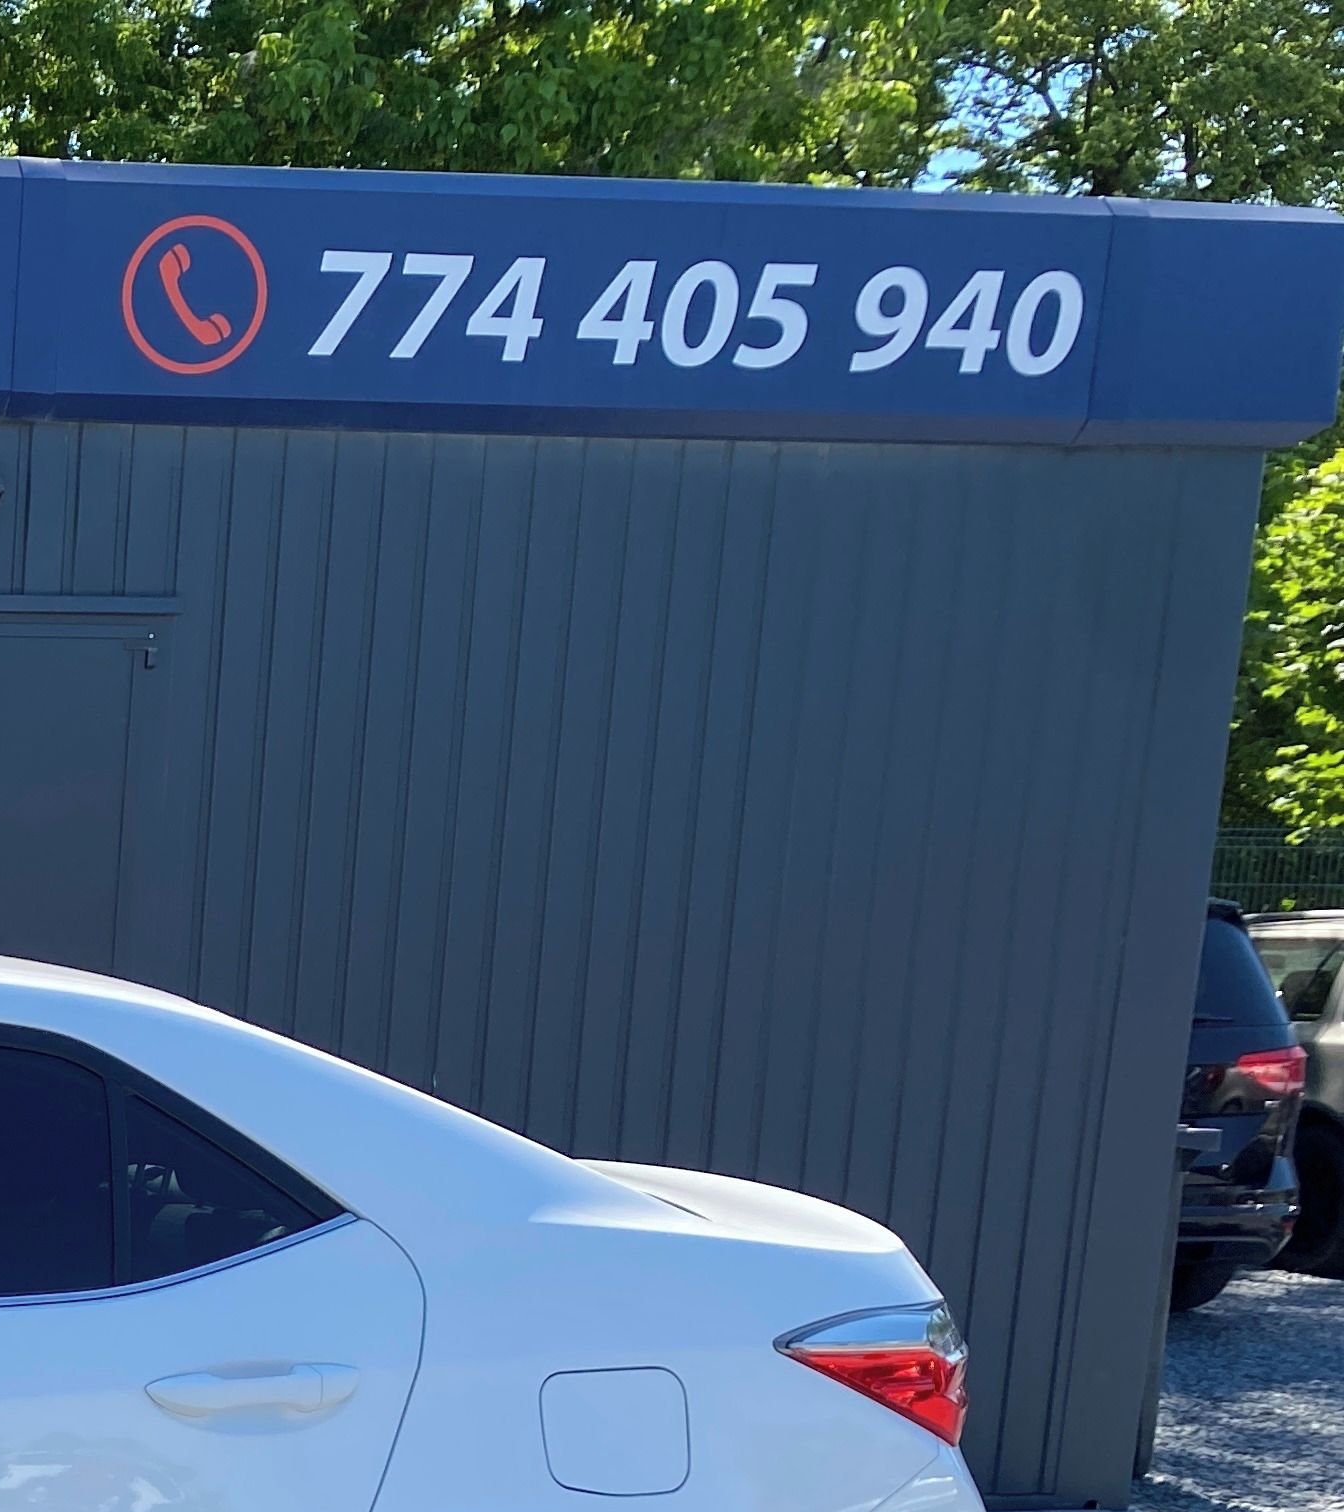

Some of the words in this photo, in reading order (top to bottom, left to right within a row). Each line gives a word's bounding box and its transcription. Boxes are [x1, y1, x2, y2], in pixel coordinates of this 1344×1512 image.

[308, 251, 545, 361] 774
[577, 261, 817, 367] 405
[850, 268, 1082, 374] 940
